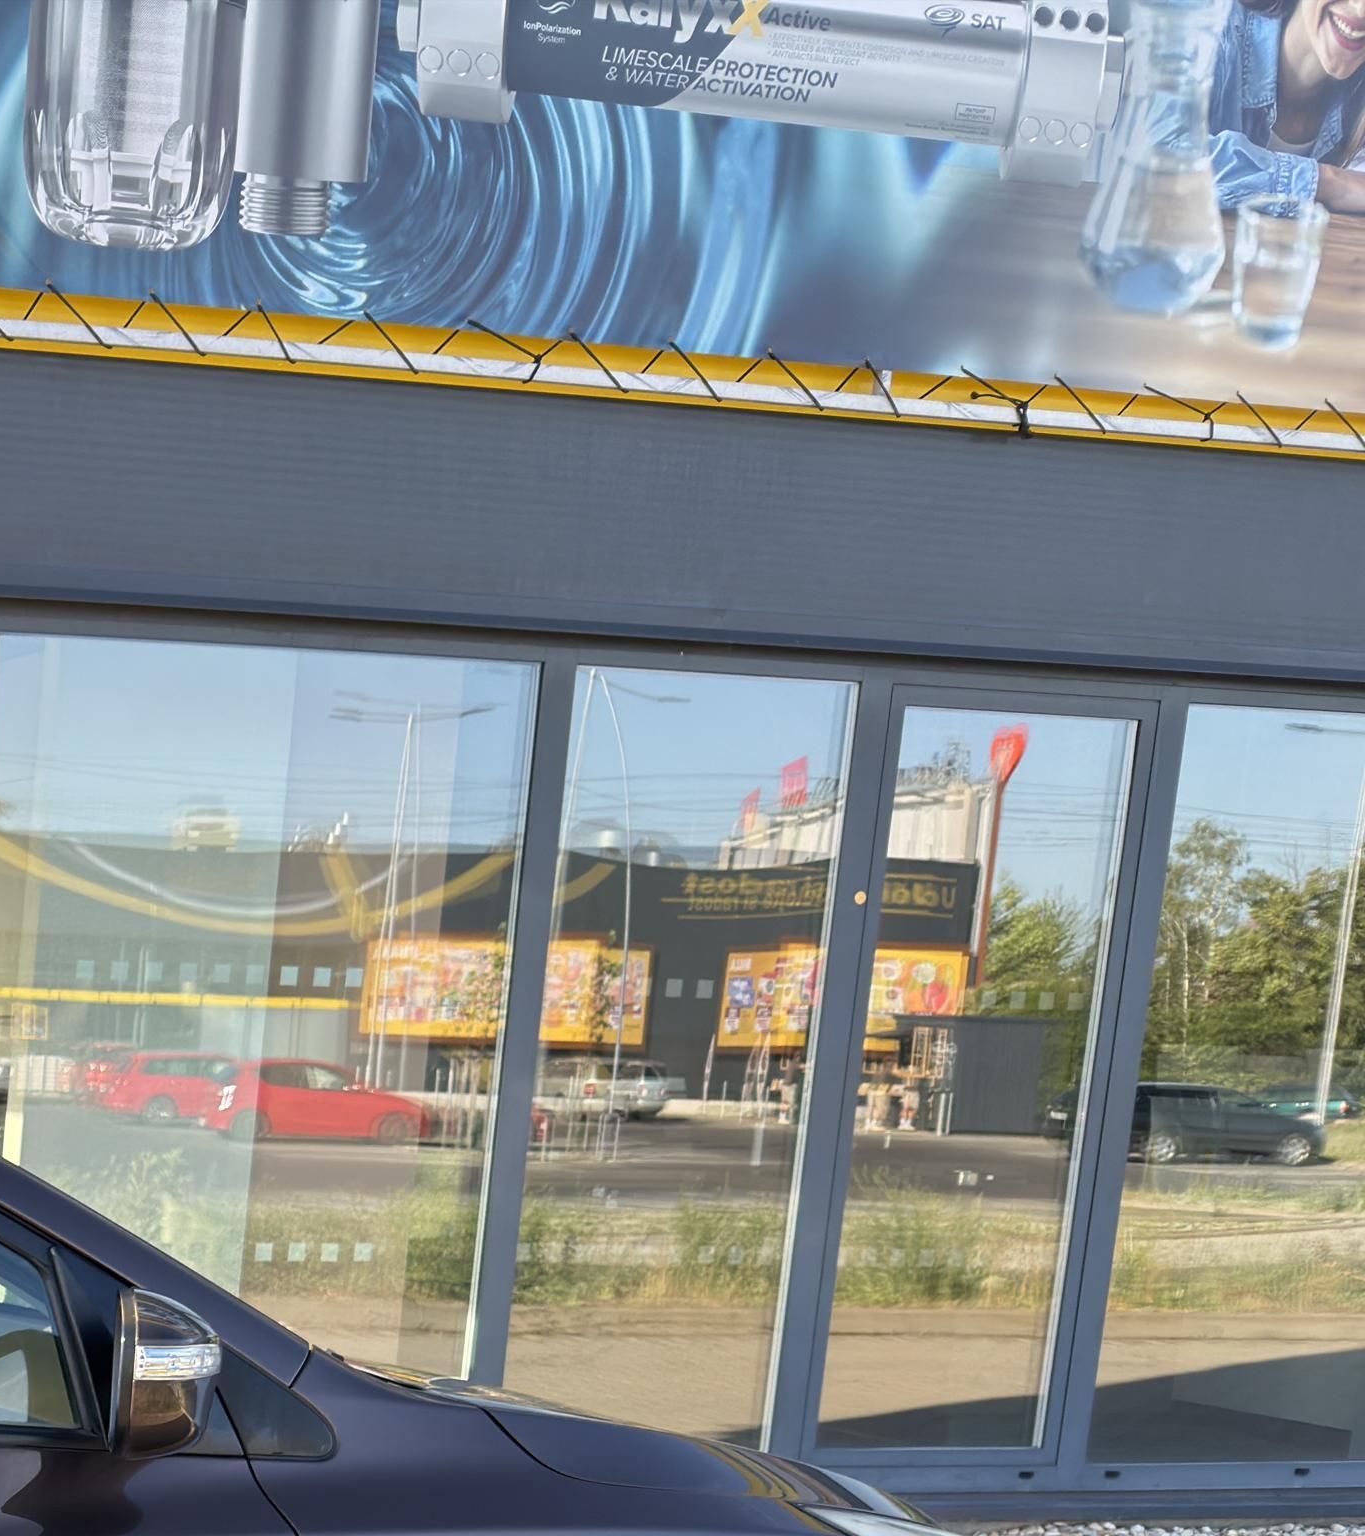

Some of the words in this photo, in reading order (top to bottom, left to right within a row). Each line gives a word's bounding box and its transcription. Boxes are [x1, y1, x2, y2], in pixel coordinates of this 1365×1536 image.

[523, 20, 581, 36] IonPolarization
[764, 6, 831, 32] Active
[971, 13, 1006, 31] SAT
[537, 33, 566, 45] System
[602, 46, 709, 73] LIMESCALE
[711, 59, 838, 89] PROTECTION
[605, 66, 619, 81] &
[625, 68, 690, 90] WATER
[692, 78, 810, 103] ACTIVATION
